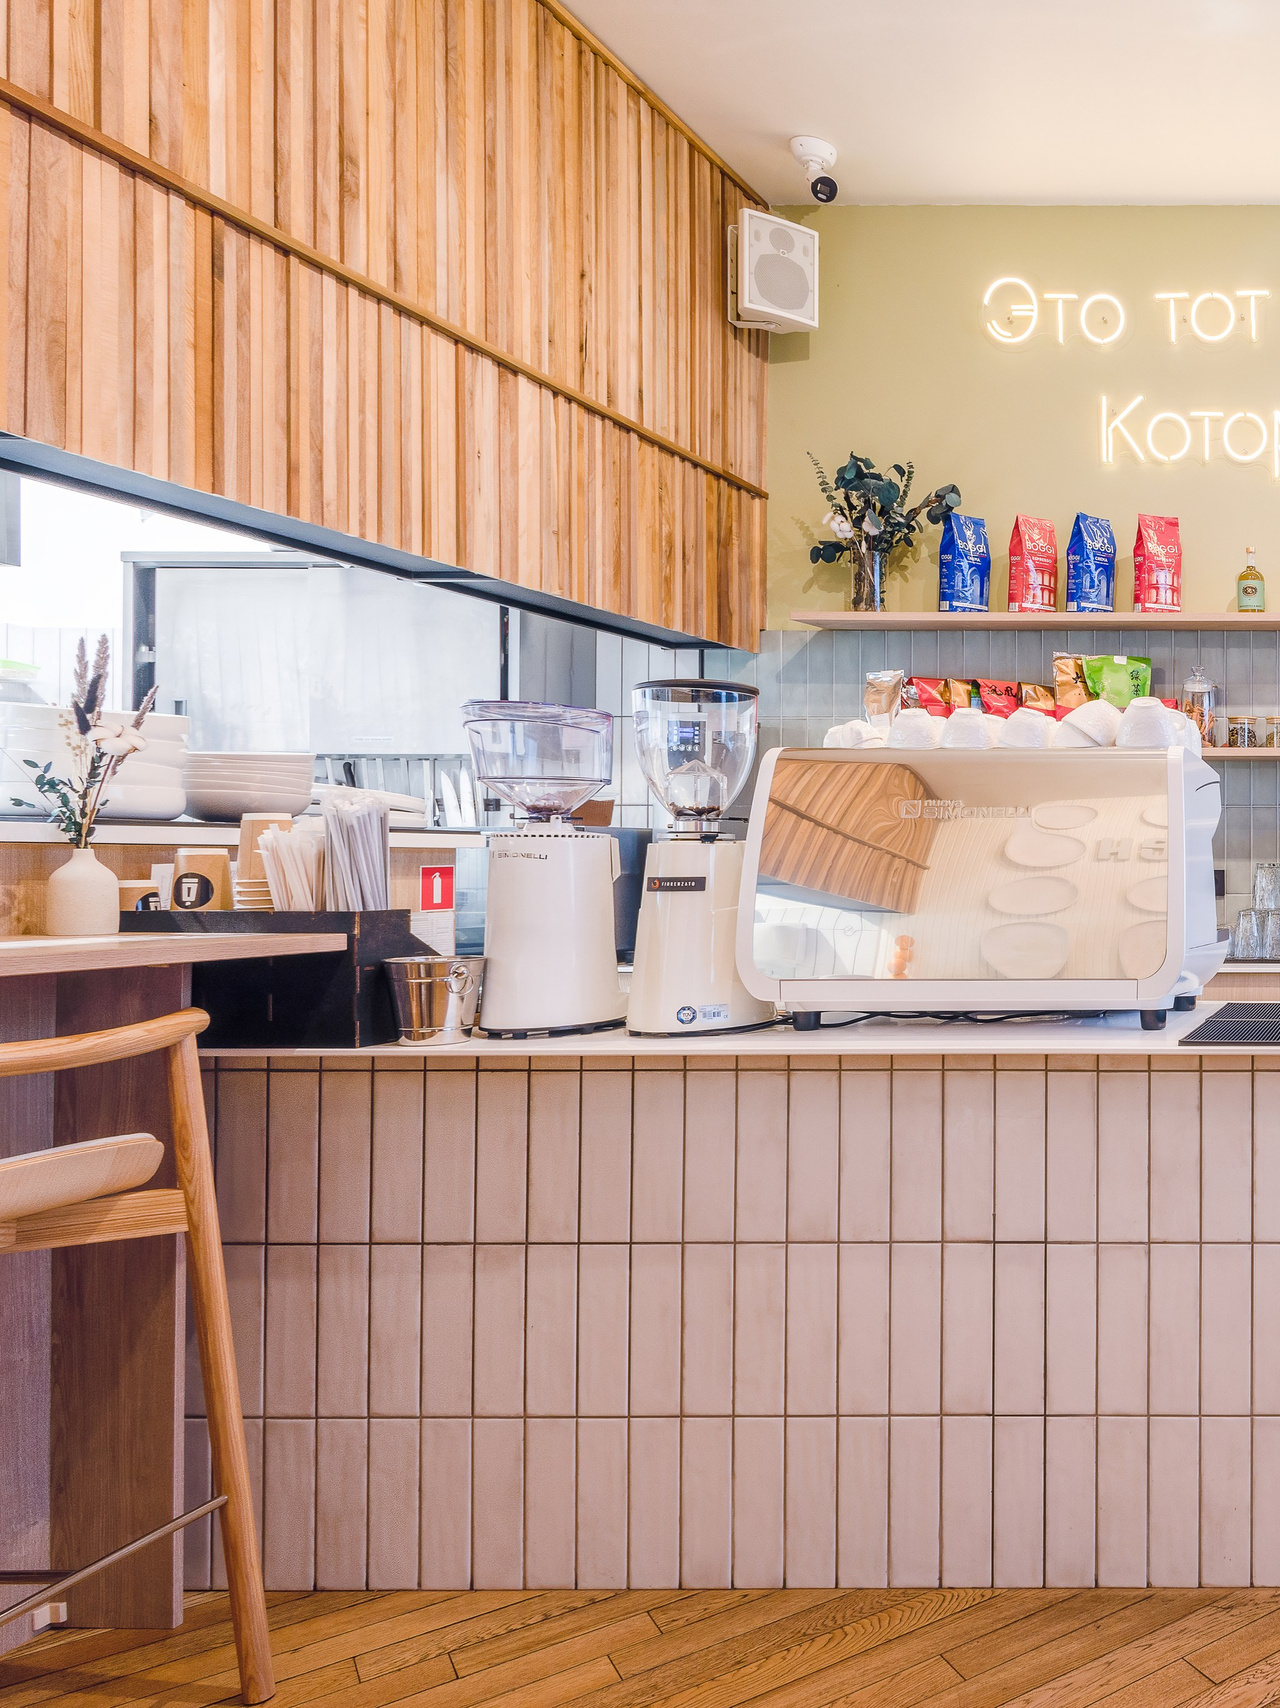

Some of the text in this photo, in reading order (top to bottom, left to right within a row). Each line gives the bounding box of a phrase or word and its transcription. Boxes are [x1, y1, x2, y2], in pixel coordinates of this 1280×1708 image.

[983, 277, 1125, 346] Это
[1155, 289, 1271, 344] тот
[958, 540, 987, 554] BOGGI
[1026, 539, 1055, 555] BOGGI
[1086, 540, 1114, 553] BOGGI
[923, 806, 1032, 819] SIMONELLI
